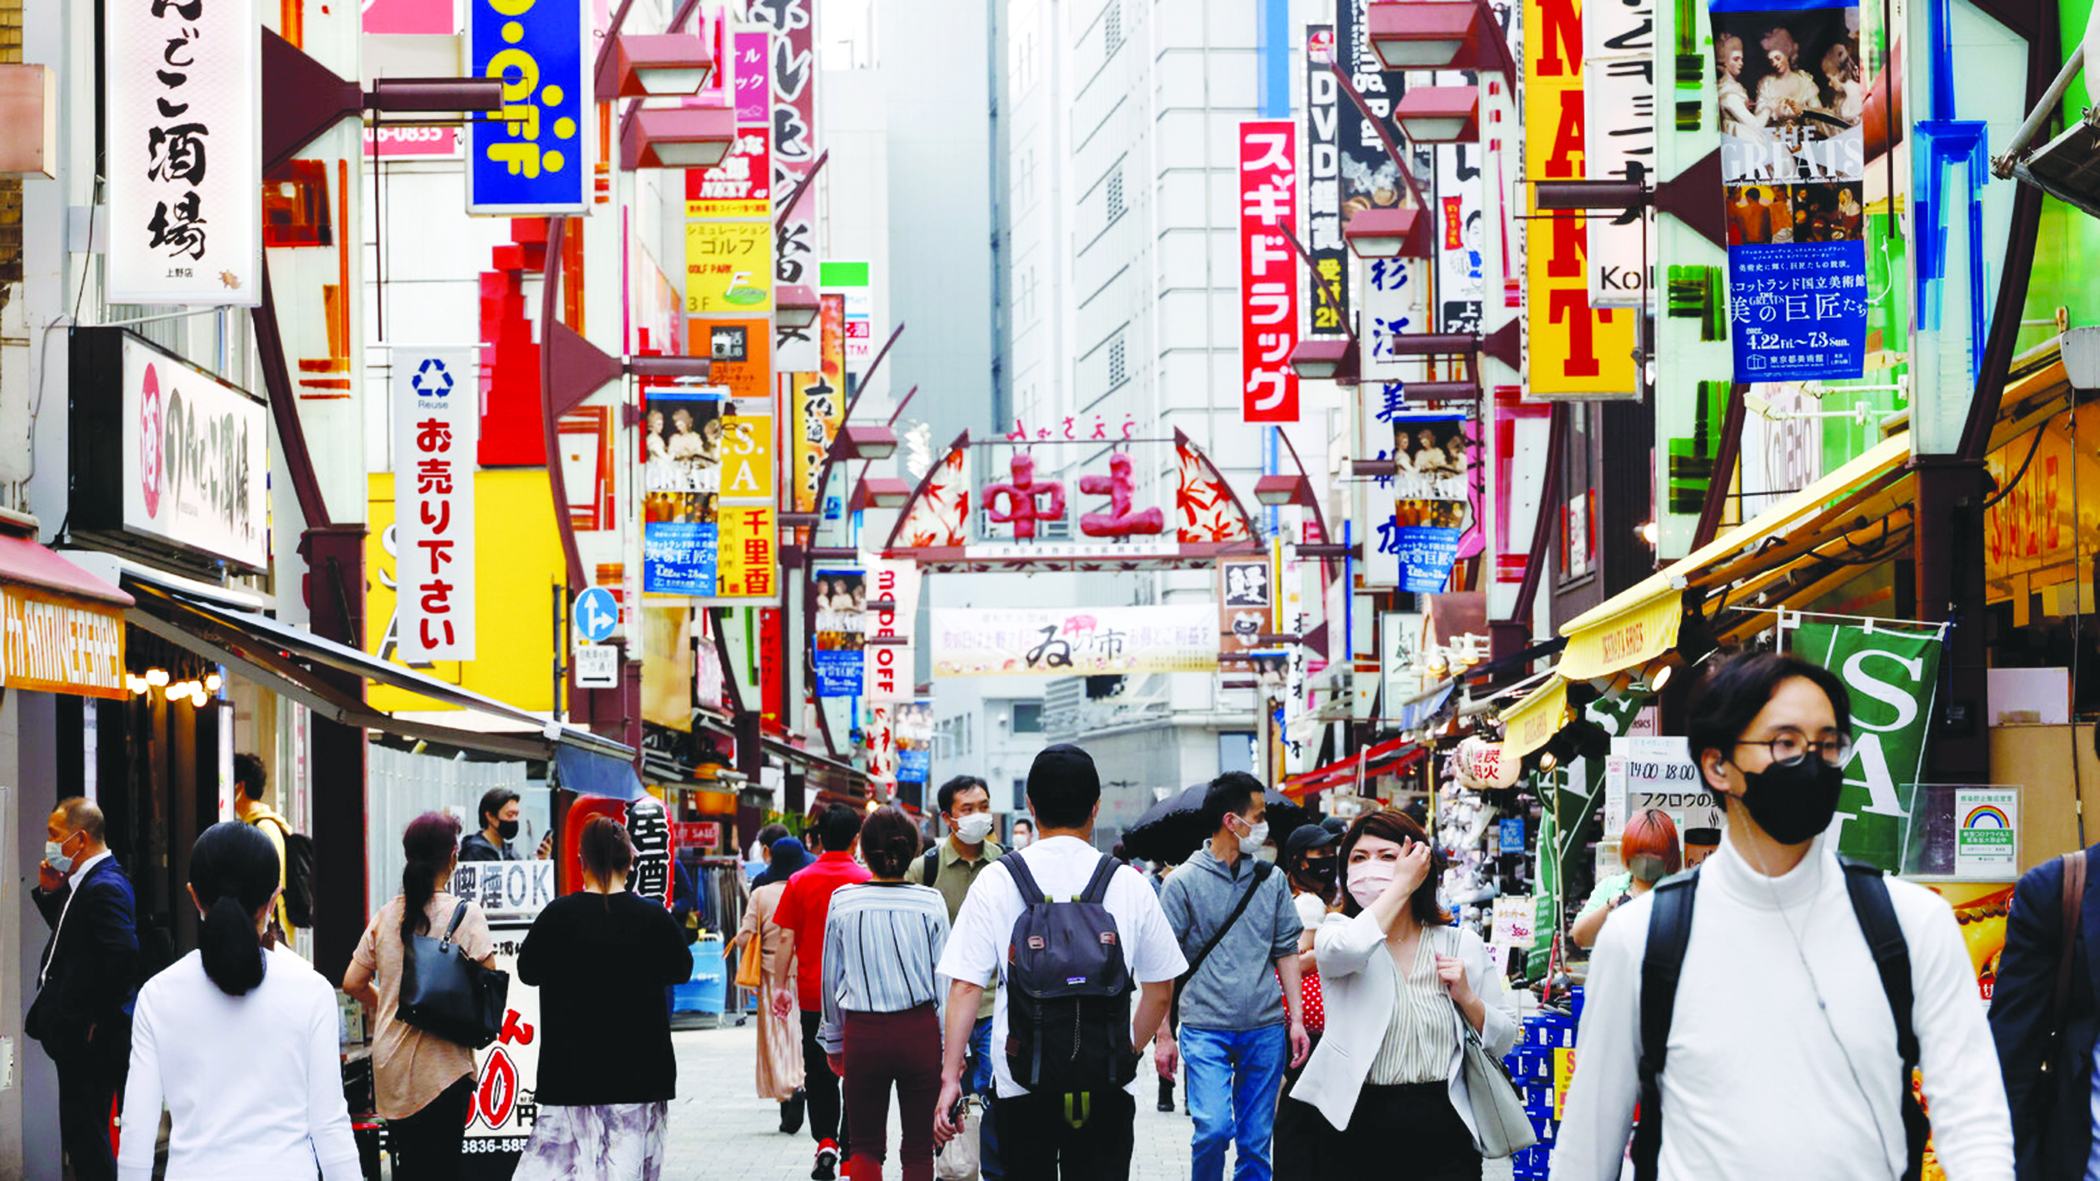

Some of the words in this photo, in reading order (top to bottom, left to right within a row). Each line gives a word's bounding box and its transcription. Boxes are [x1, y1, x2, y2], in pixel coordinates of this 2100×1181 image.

[1722, 139, 1864, 180] GREATS
[687, 226, 769, 235] シミュレーション
[701, 238, 755, 255] ゴルフ
[165, 267, 194, 278] 上野店
[688, 265, 708, 274] GOLF
[711, 265, 732, 274] PARK
[1243, 133, 1297, 411] スギドラッグ
[688, 297, 710, 311] 3F
[1731, 293, 1868, 324] 美の巨匠たち
[1770, 354, 1824, 364] 東京都美術館
[418, 400, 449, 409] Reuse
[730, 460, 760, 490] A
[416, 417, 455, 650] お売り下さい
[743, 509, 770, 594] 千里香
[876, 649, 894, 693] OFF
[1484, 750, 1500, 780] 炭火
[453, 863, 551, 909] 喫煙OK
[517, 1103, 537, 1127] 円
